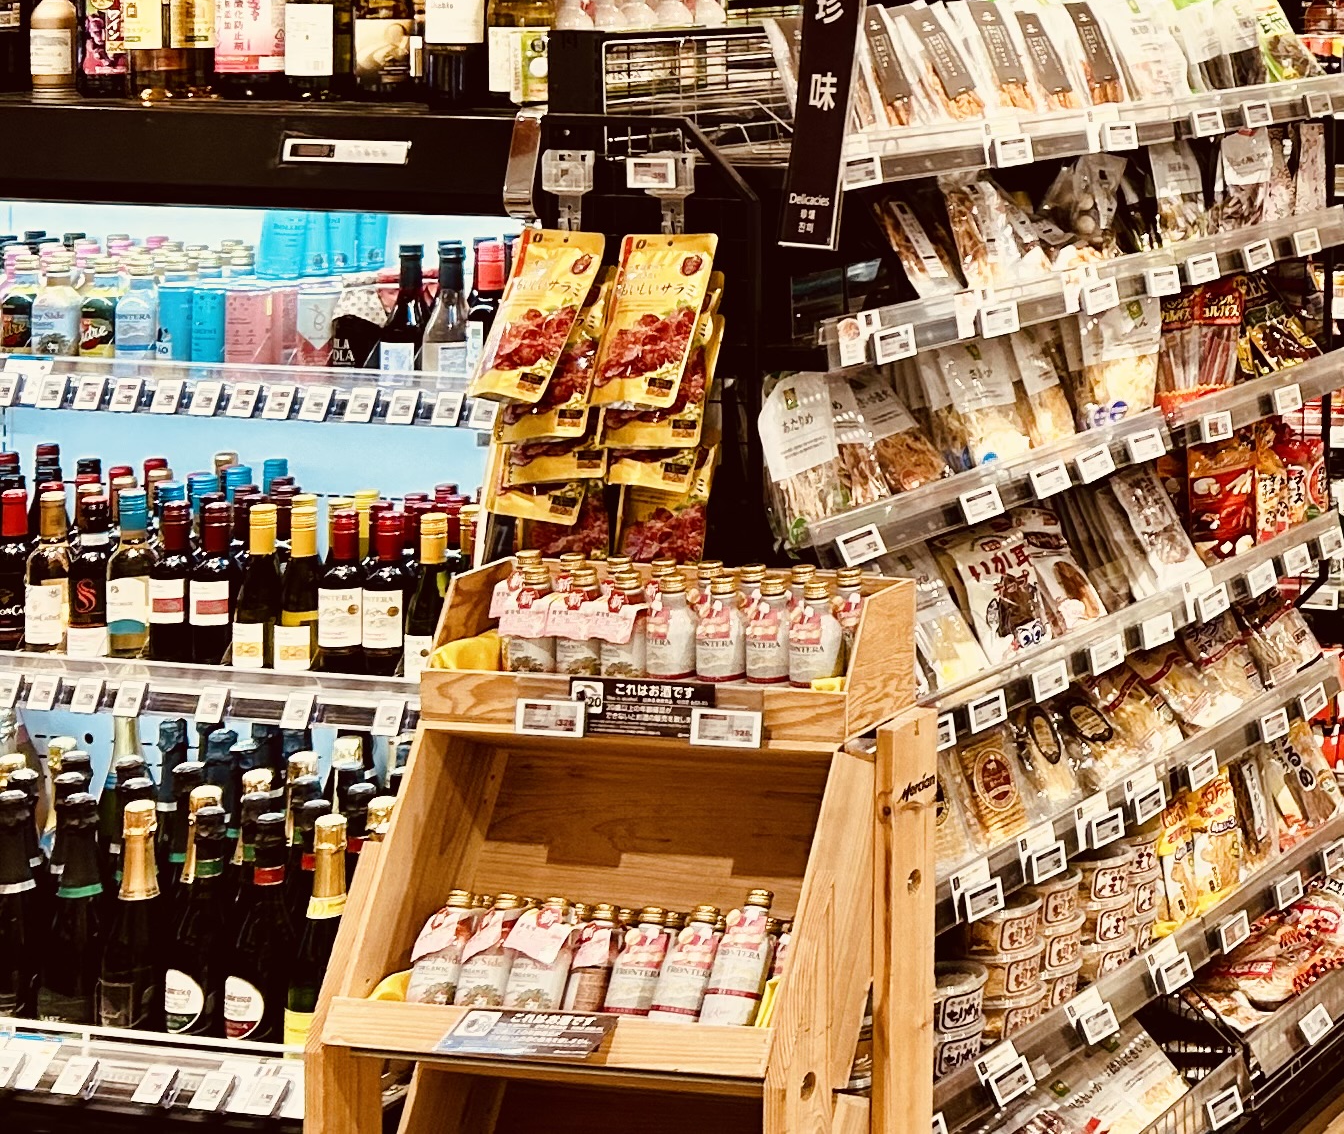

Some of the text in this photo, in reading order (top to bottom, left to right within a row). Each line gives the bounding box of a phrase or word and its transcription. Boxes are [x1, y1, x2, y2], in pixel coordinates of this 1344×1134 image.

[789, 191, 831, 207] Delicacies
[612, 681, 696, 699] これはお酒です
